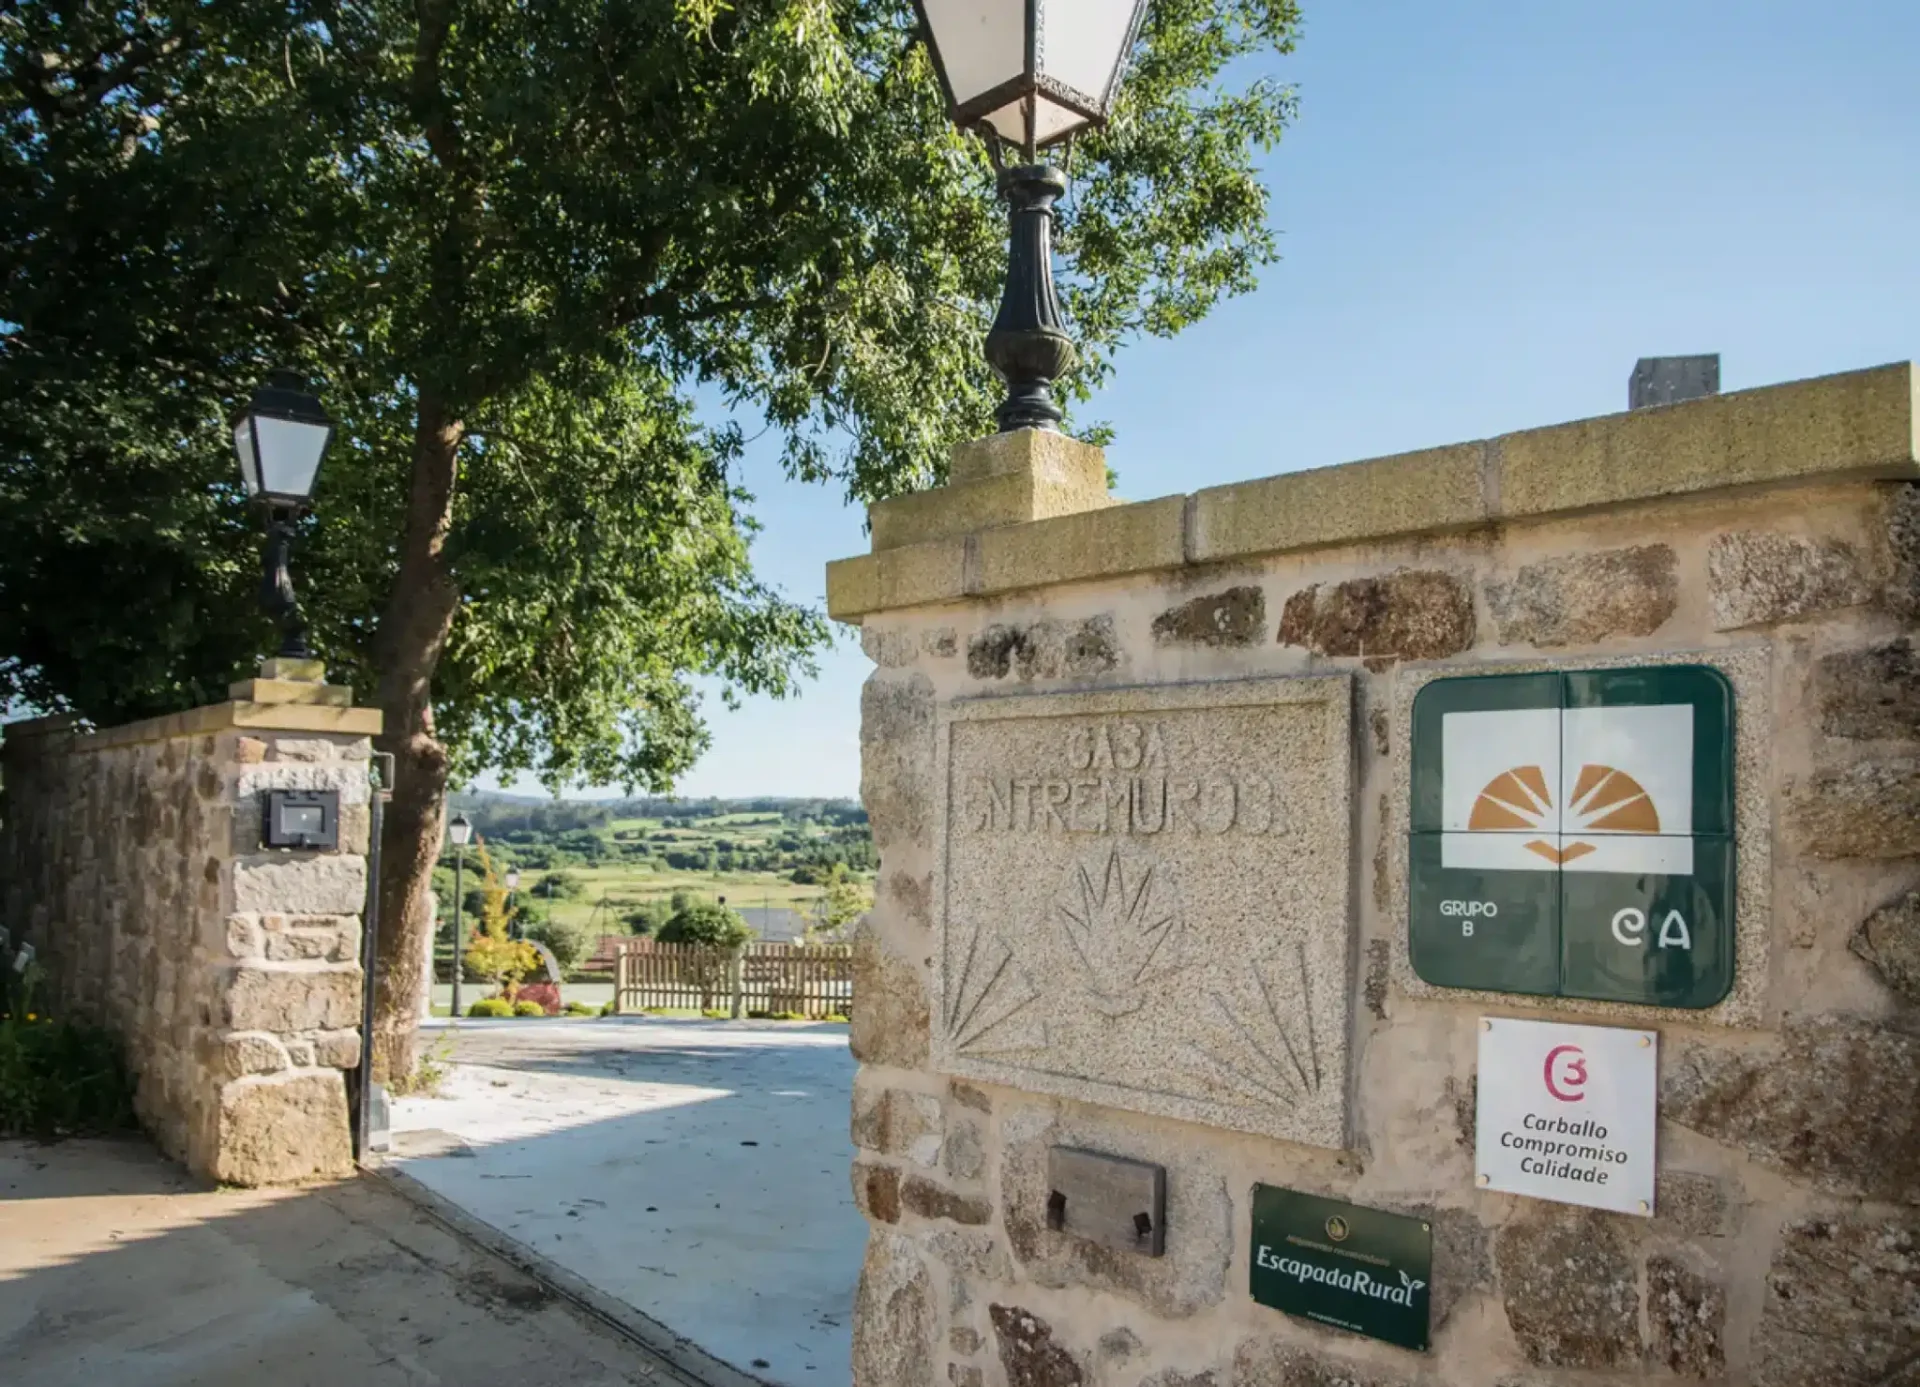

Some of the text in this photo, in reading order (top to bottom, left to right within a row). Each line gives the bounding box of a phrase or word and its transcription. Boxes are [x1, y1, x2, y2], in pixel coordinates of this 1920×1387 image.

[1065, 722, 1168, 770] CASA
[1439, 899, 1498, 918] GRUPO
[1461, 920, 1475, 937] B
[1522, 1112, 1608, 1140] Carballo
[1500, 1131, 1628, 1165] Compromiso
[1520, 1156, 1609, 1185] Calidade
[1256, 1244, 1416, 1308] EscapadaRural
